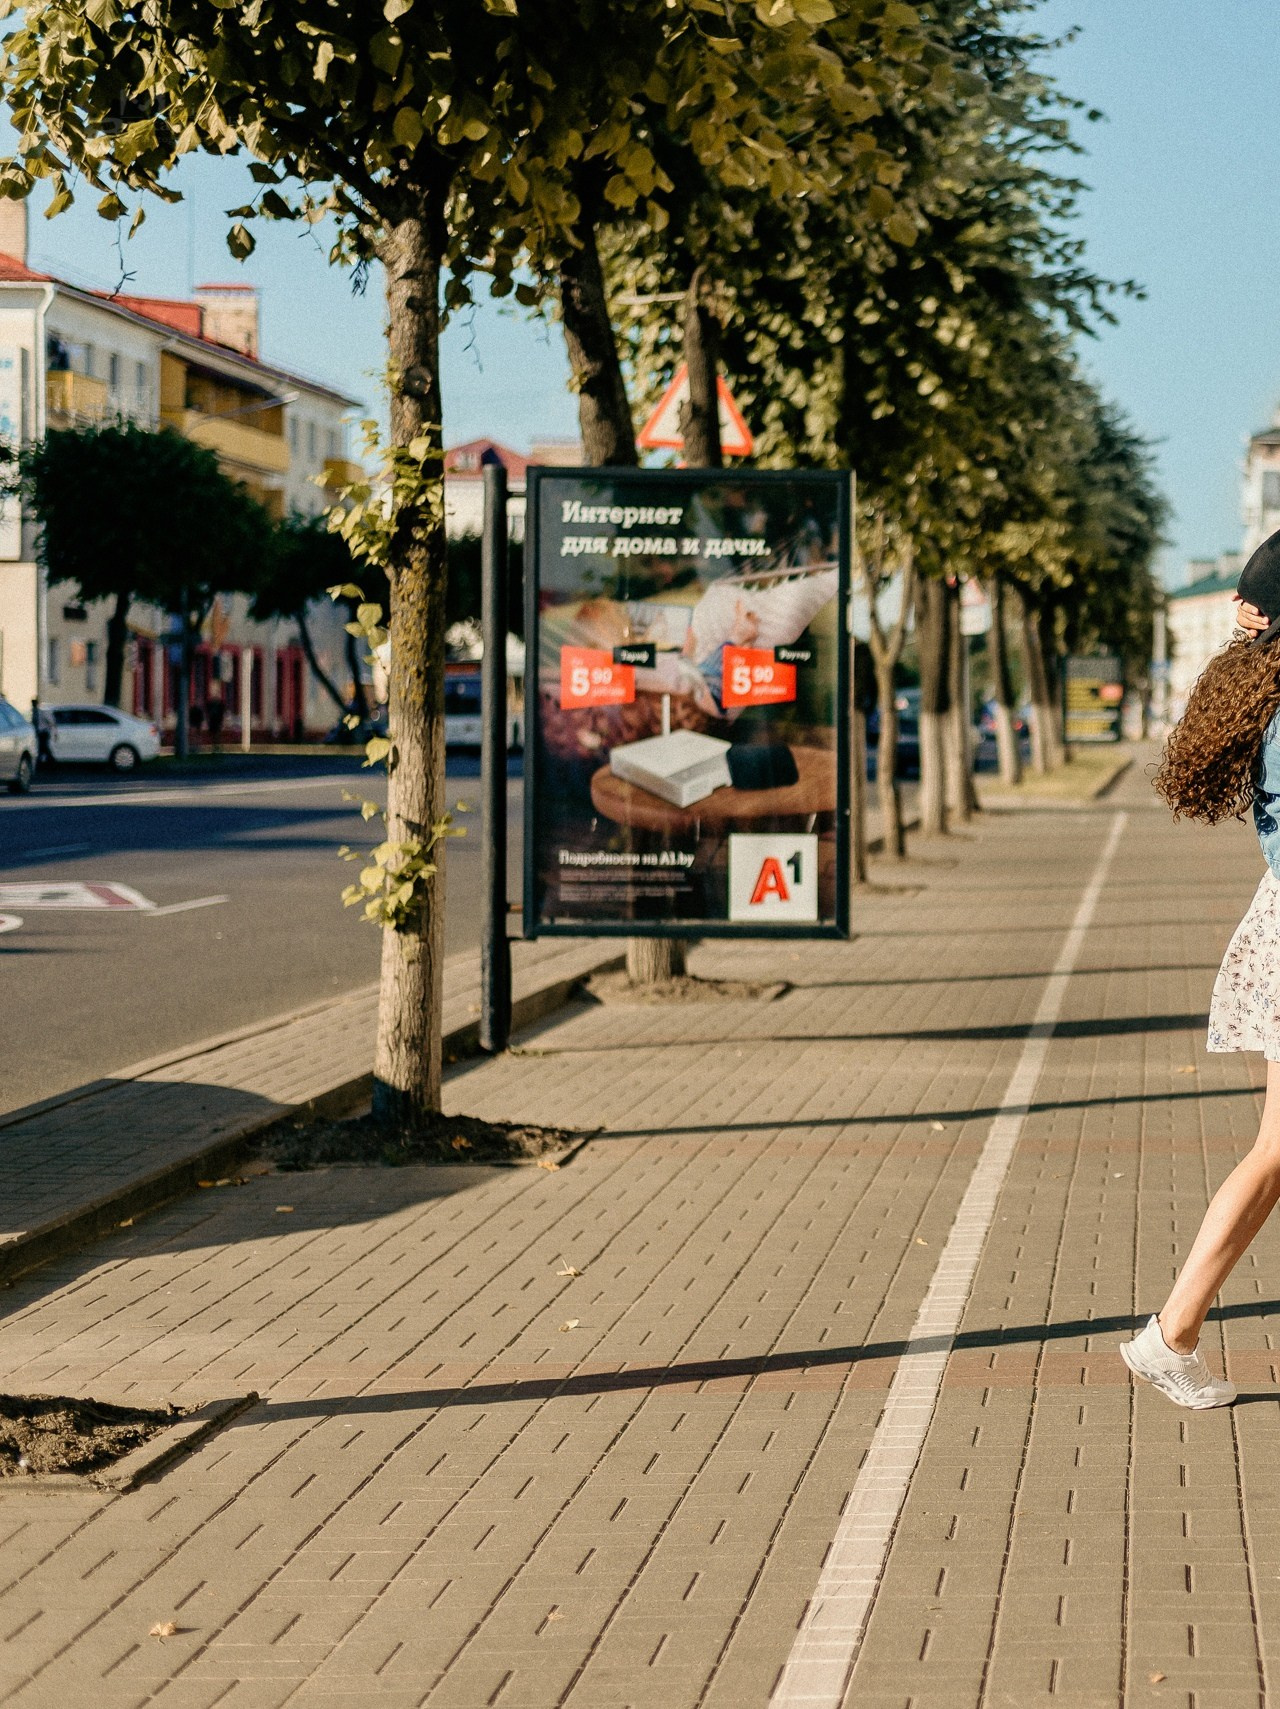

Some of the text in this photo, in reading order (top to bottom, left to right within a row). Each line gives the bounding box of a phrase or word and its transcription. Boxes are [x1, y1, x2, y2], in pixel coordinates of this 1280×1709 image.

[561, 500, 683, 529] Интернет
[561, 536, 771, 558] для дома и дачи.
[559, 850, 640, 867] Подробности
[642, 852, 658, 866] на
[750, 851, 803, 905] A1
